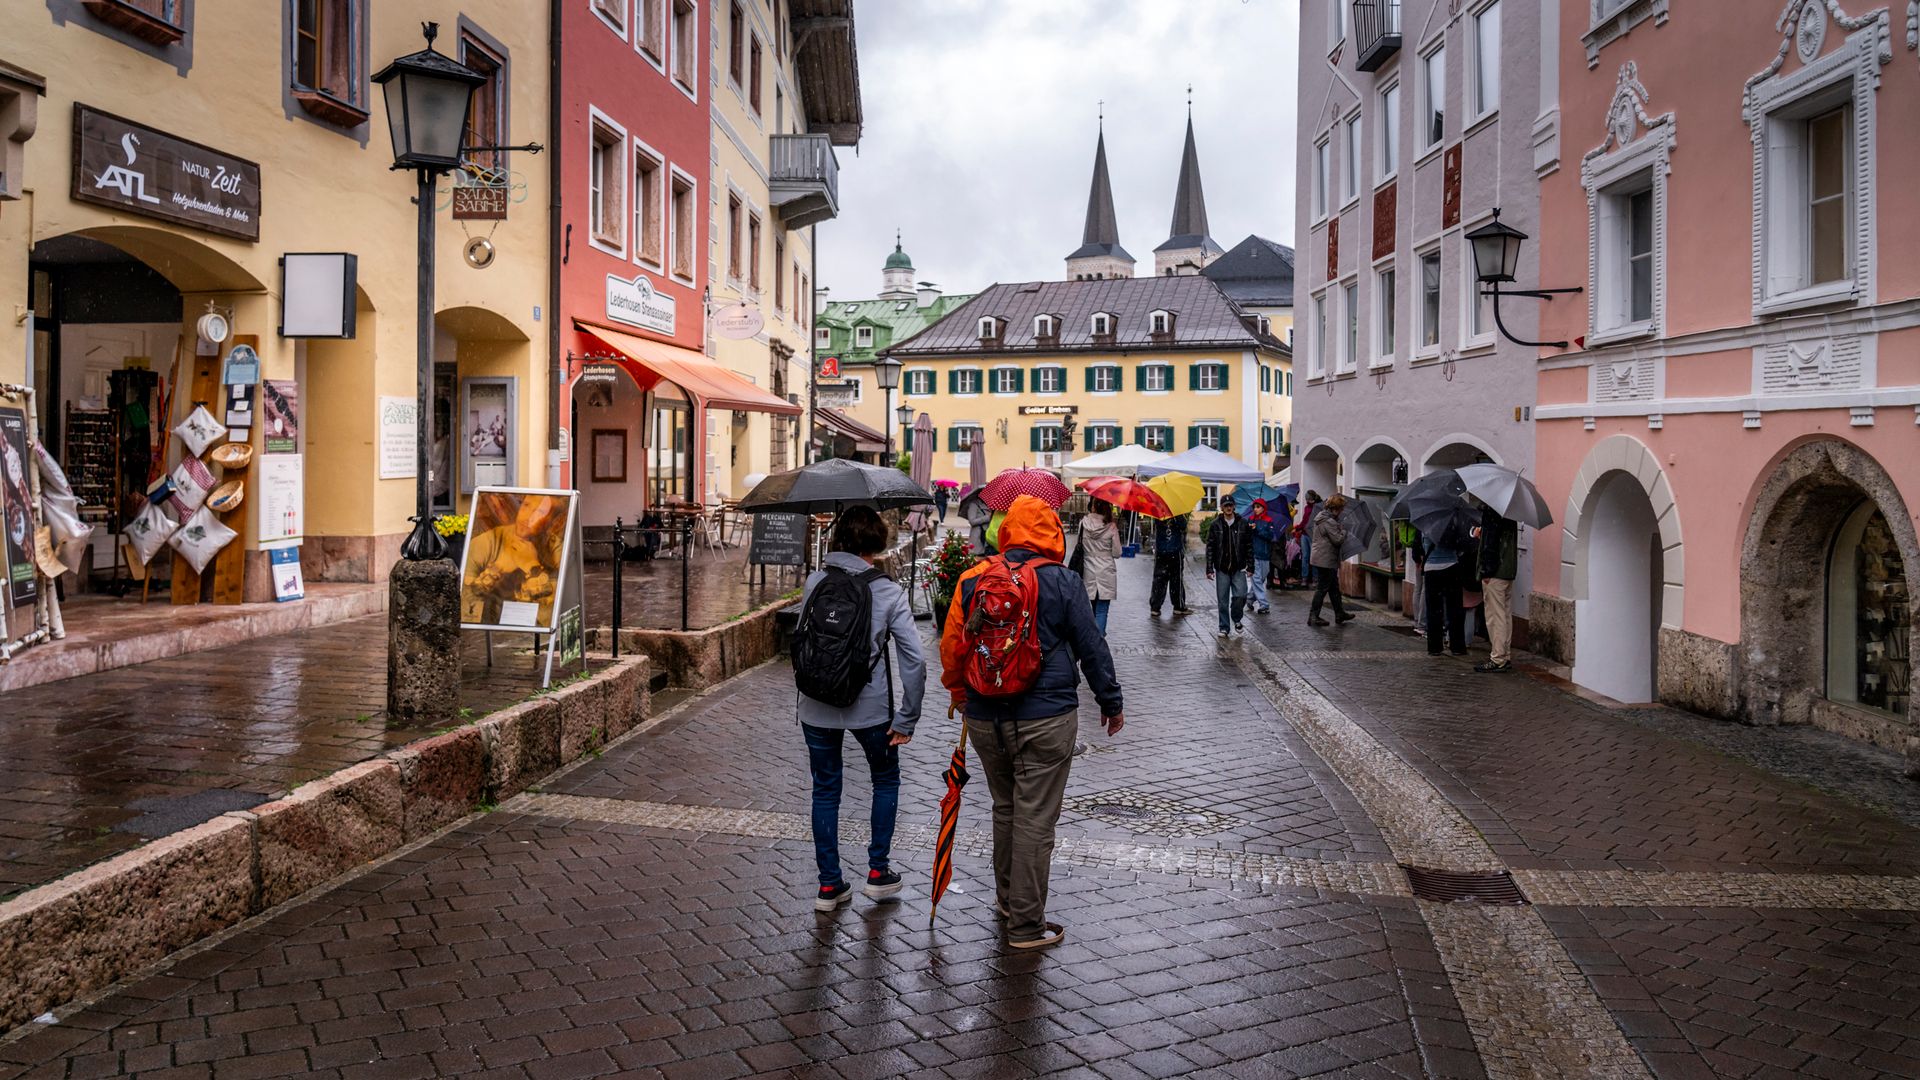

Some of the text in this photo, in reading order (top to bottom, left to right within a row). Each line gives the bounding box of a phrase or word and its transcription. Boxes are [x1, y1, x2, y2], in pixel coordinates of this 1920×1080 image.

[182, 160, 241, 196] NATUR Zeit
[94, 165, 160, 205] ATL
[456, 188, 504, 200] SALON
[172, 192, 249, 223] Holzuhrenladen & Mehr
[455, 200, 505, 213] SABINE
[610, 290, 641, 314] Lederhosen
[716, 318, 760, 327] Lederstub'n
[583, 365, 616, 374] Lederhosen
[761, 513, 796, 521] MERCHANT
